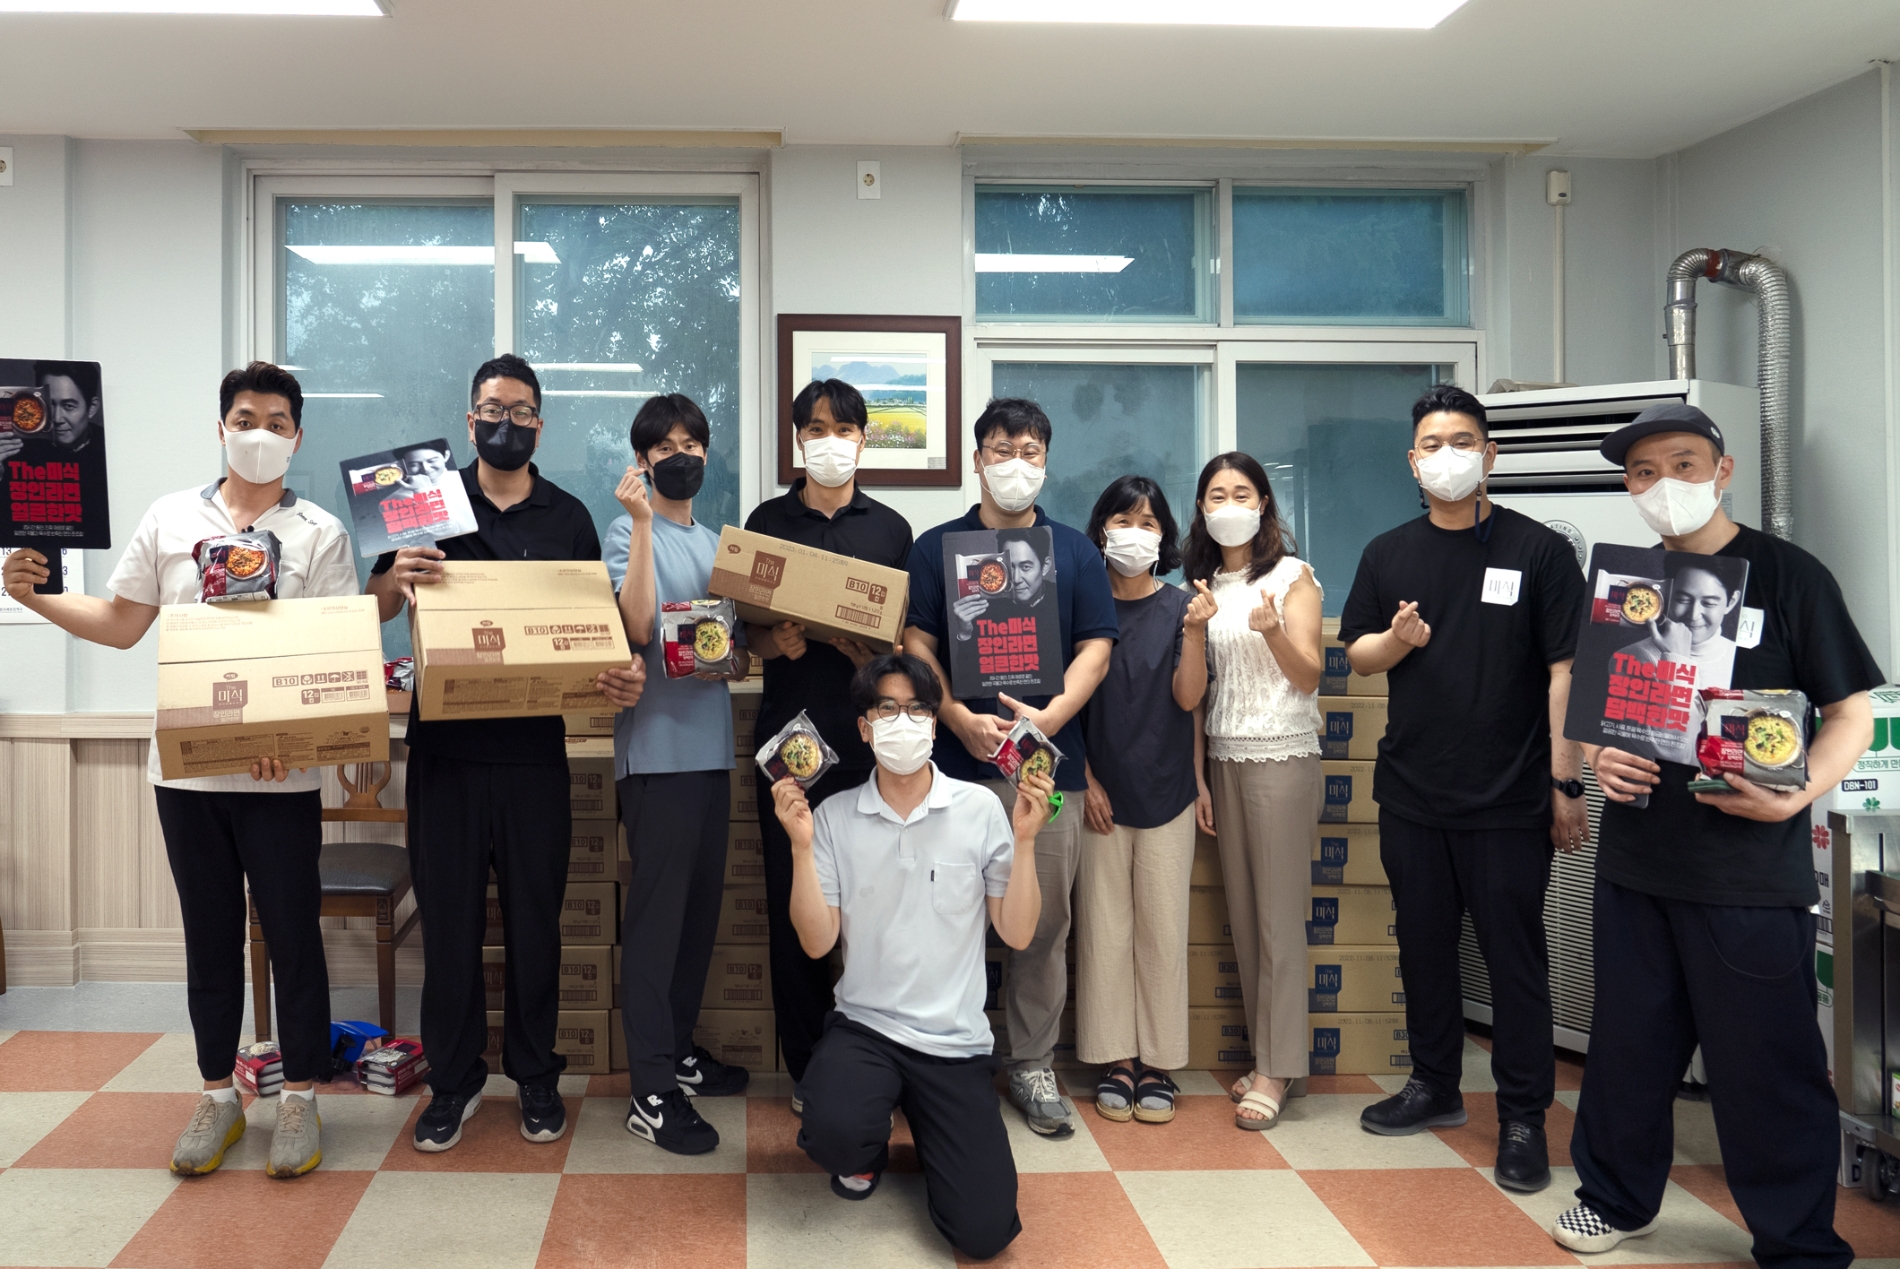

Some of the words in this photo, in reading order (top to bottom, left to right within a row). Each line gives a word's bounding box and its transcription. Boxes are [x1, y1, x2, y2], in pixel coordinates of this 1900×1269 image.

[8, 461, 80, 480] The미식
[9, 482, 81, 501] 장인라면
[380, 489, 442, 511] The미식
[11, 503, 82, 522] 얼큰한맛
[382, 499, 446, 522] 장인라면
[1550, 524, 1572, 534] ATING
[756, 562, 780, 582] 미식
[849, 580, 866, 591] B10
[976, 617, 1036, 636] The미식
[1739, 620, 1755, 638] 식
[478, 634, 501, 647] 미식
[978, 635, 1038, 655] 장인라면
[979, 654, 1040, 674] 얼큰한맛
[1329, 656, 1348, 670] 미식
[1613, 652, 1697, 686] The미식
[276, 678, 296, 686] B10
[218, 688, 242, 703] 미식
[1608, 674, 1694, 709] 장인라면
[214, 710, 240, 718] 장인라면
[1604, 697, 1690, 733] 담백한맛
[1330, 721, 1349, 734] 미식
[1858, 760, 1888, 770] 정직하게
[1891, 760, 1900, 768] 만
[1329, 784, 1348, 798] 미식
[1324, 846, 1344, 860] 미식
[1316, 906, 1335, 920] 미식
[1318, 974, 1338, 987] 미식
[1317, 1037, 1336, 1050] 미식
